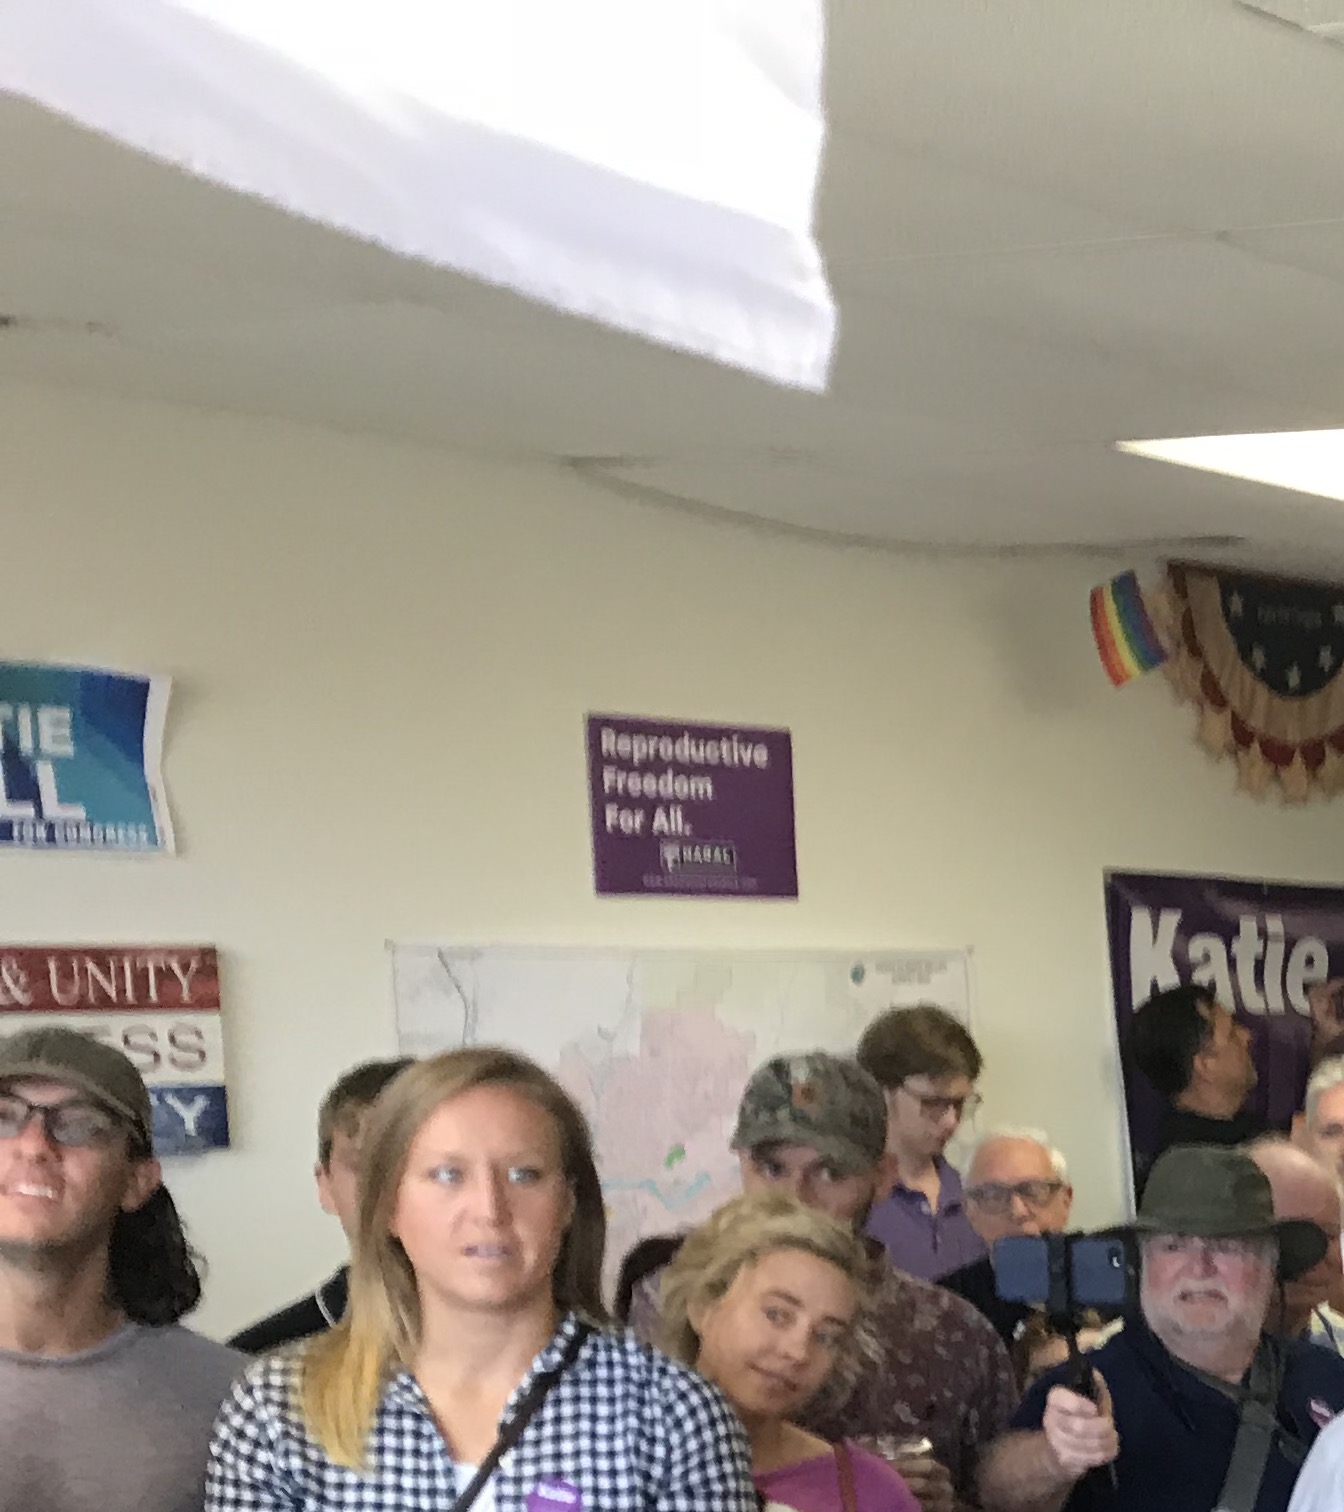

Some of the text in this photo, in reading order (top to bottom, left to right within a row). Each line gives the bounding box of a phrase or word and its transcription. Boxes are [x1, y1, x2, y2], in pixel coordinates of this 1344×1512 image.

[602, 727, 768, 769] Reproductive
[603, 765, 714, 801] Freedom
[605, 802, 692, 836] For All.
[48, 955, 201, 1005] UNITY
[1130, 906, 1329, 1017] Katie
